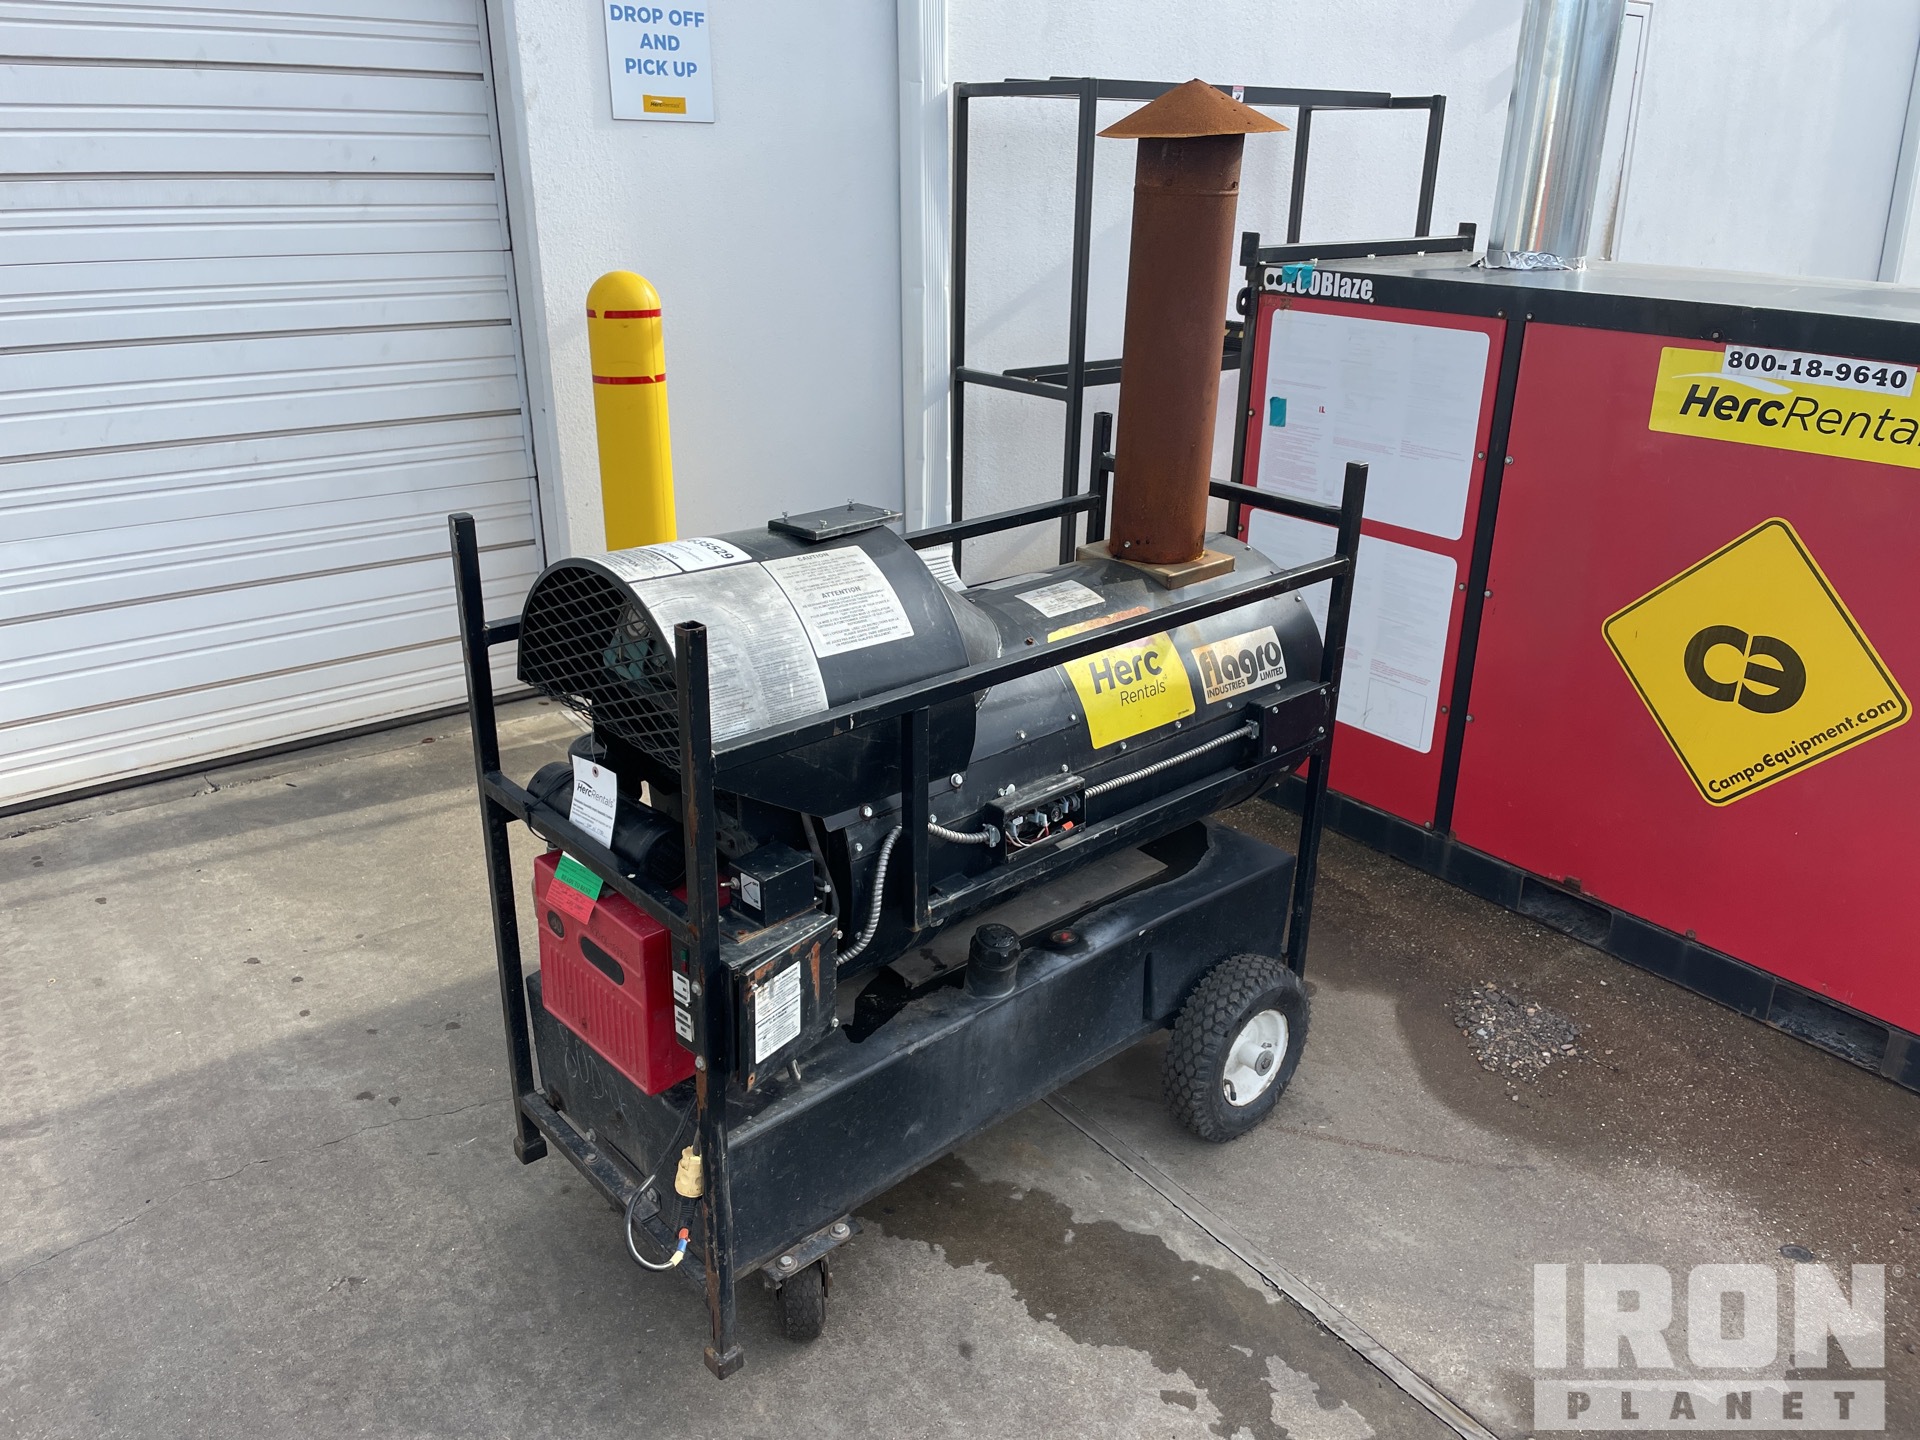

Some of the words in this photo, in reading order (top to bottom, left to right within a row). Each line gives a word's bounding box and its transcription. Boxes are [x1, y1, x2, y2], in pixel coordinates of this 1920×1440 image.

[610, 4, 663, 24] DROP
[669, 9, 704, 27] OFF
[640, 33, 680, 51] AND
[625, 58, 668, 76] PICK
[673, 61, 697, 77] UP
[1727, 351, 1907, 389] 800-18-9640
[1679, 384, 1920, 446] HercRenta
[797, 552, 830, 562] CAUTION
[821, 585, 861, 599] ATTENTION
[1088, 651, 1162, 694] Herc
[1198, 641, 1282, 689] flagro
[1120, 680, 1166, 706] Rentals
[1206, 678, 1246, 699] INDUSTRIES
[1259, 666, 1284, 682] LIMITED
[1708, 699, 1897, 793] CampoEquipment.com
[576, 783, 615, 808] HercRentals
